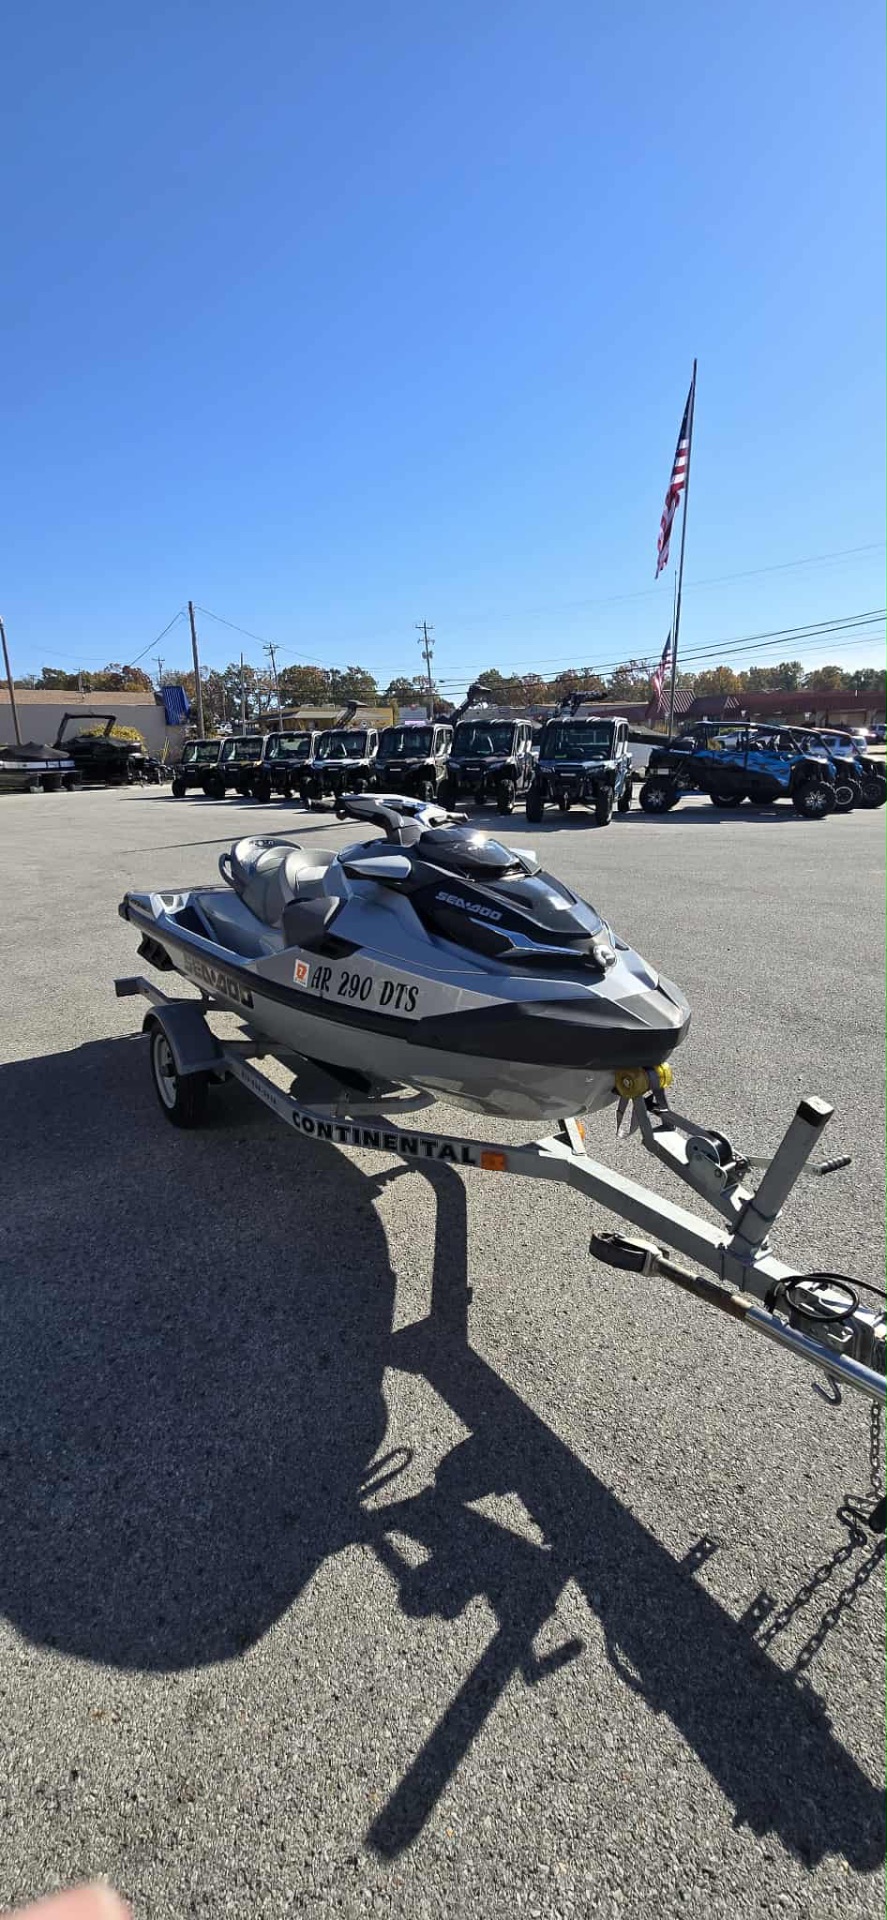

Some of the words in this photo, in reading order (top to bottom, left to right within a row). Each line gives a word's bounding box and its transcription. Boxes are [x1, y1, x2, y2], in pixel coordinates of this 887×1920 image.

[311, 966, 332, 992] AR
[337, 971, 373, 1001] 290
[379, 980, 419, 1012] DTS
[292, 1109, 476, 1165] CONTINENTAL
